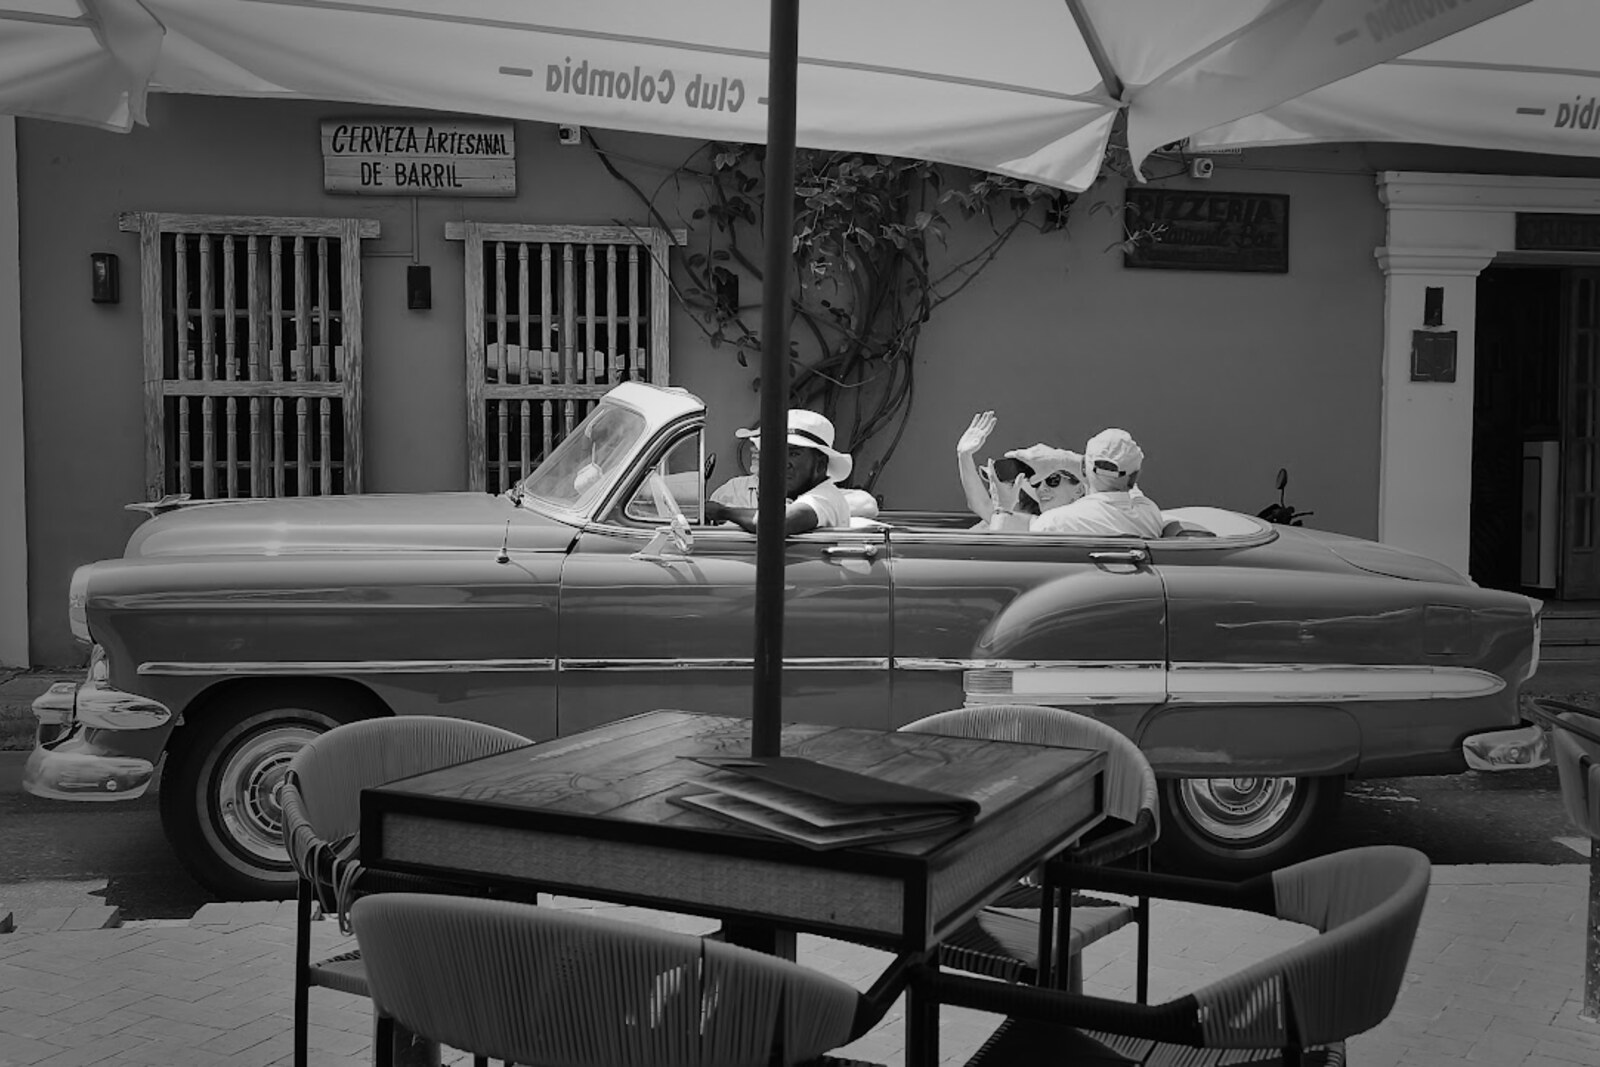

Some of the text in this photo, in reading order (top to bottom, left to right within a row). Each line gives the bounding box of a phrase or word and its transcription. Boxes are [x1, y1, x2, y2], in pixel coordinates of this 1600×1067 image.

[332, 125, 510, 155] CERVEZA ARTESANAL
[361, 162, 462, 187] DE BARRIL
[1138, 194, 1275, 223] PIZZERIA
